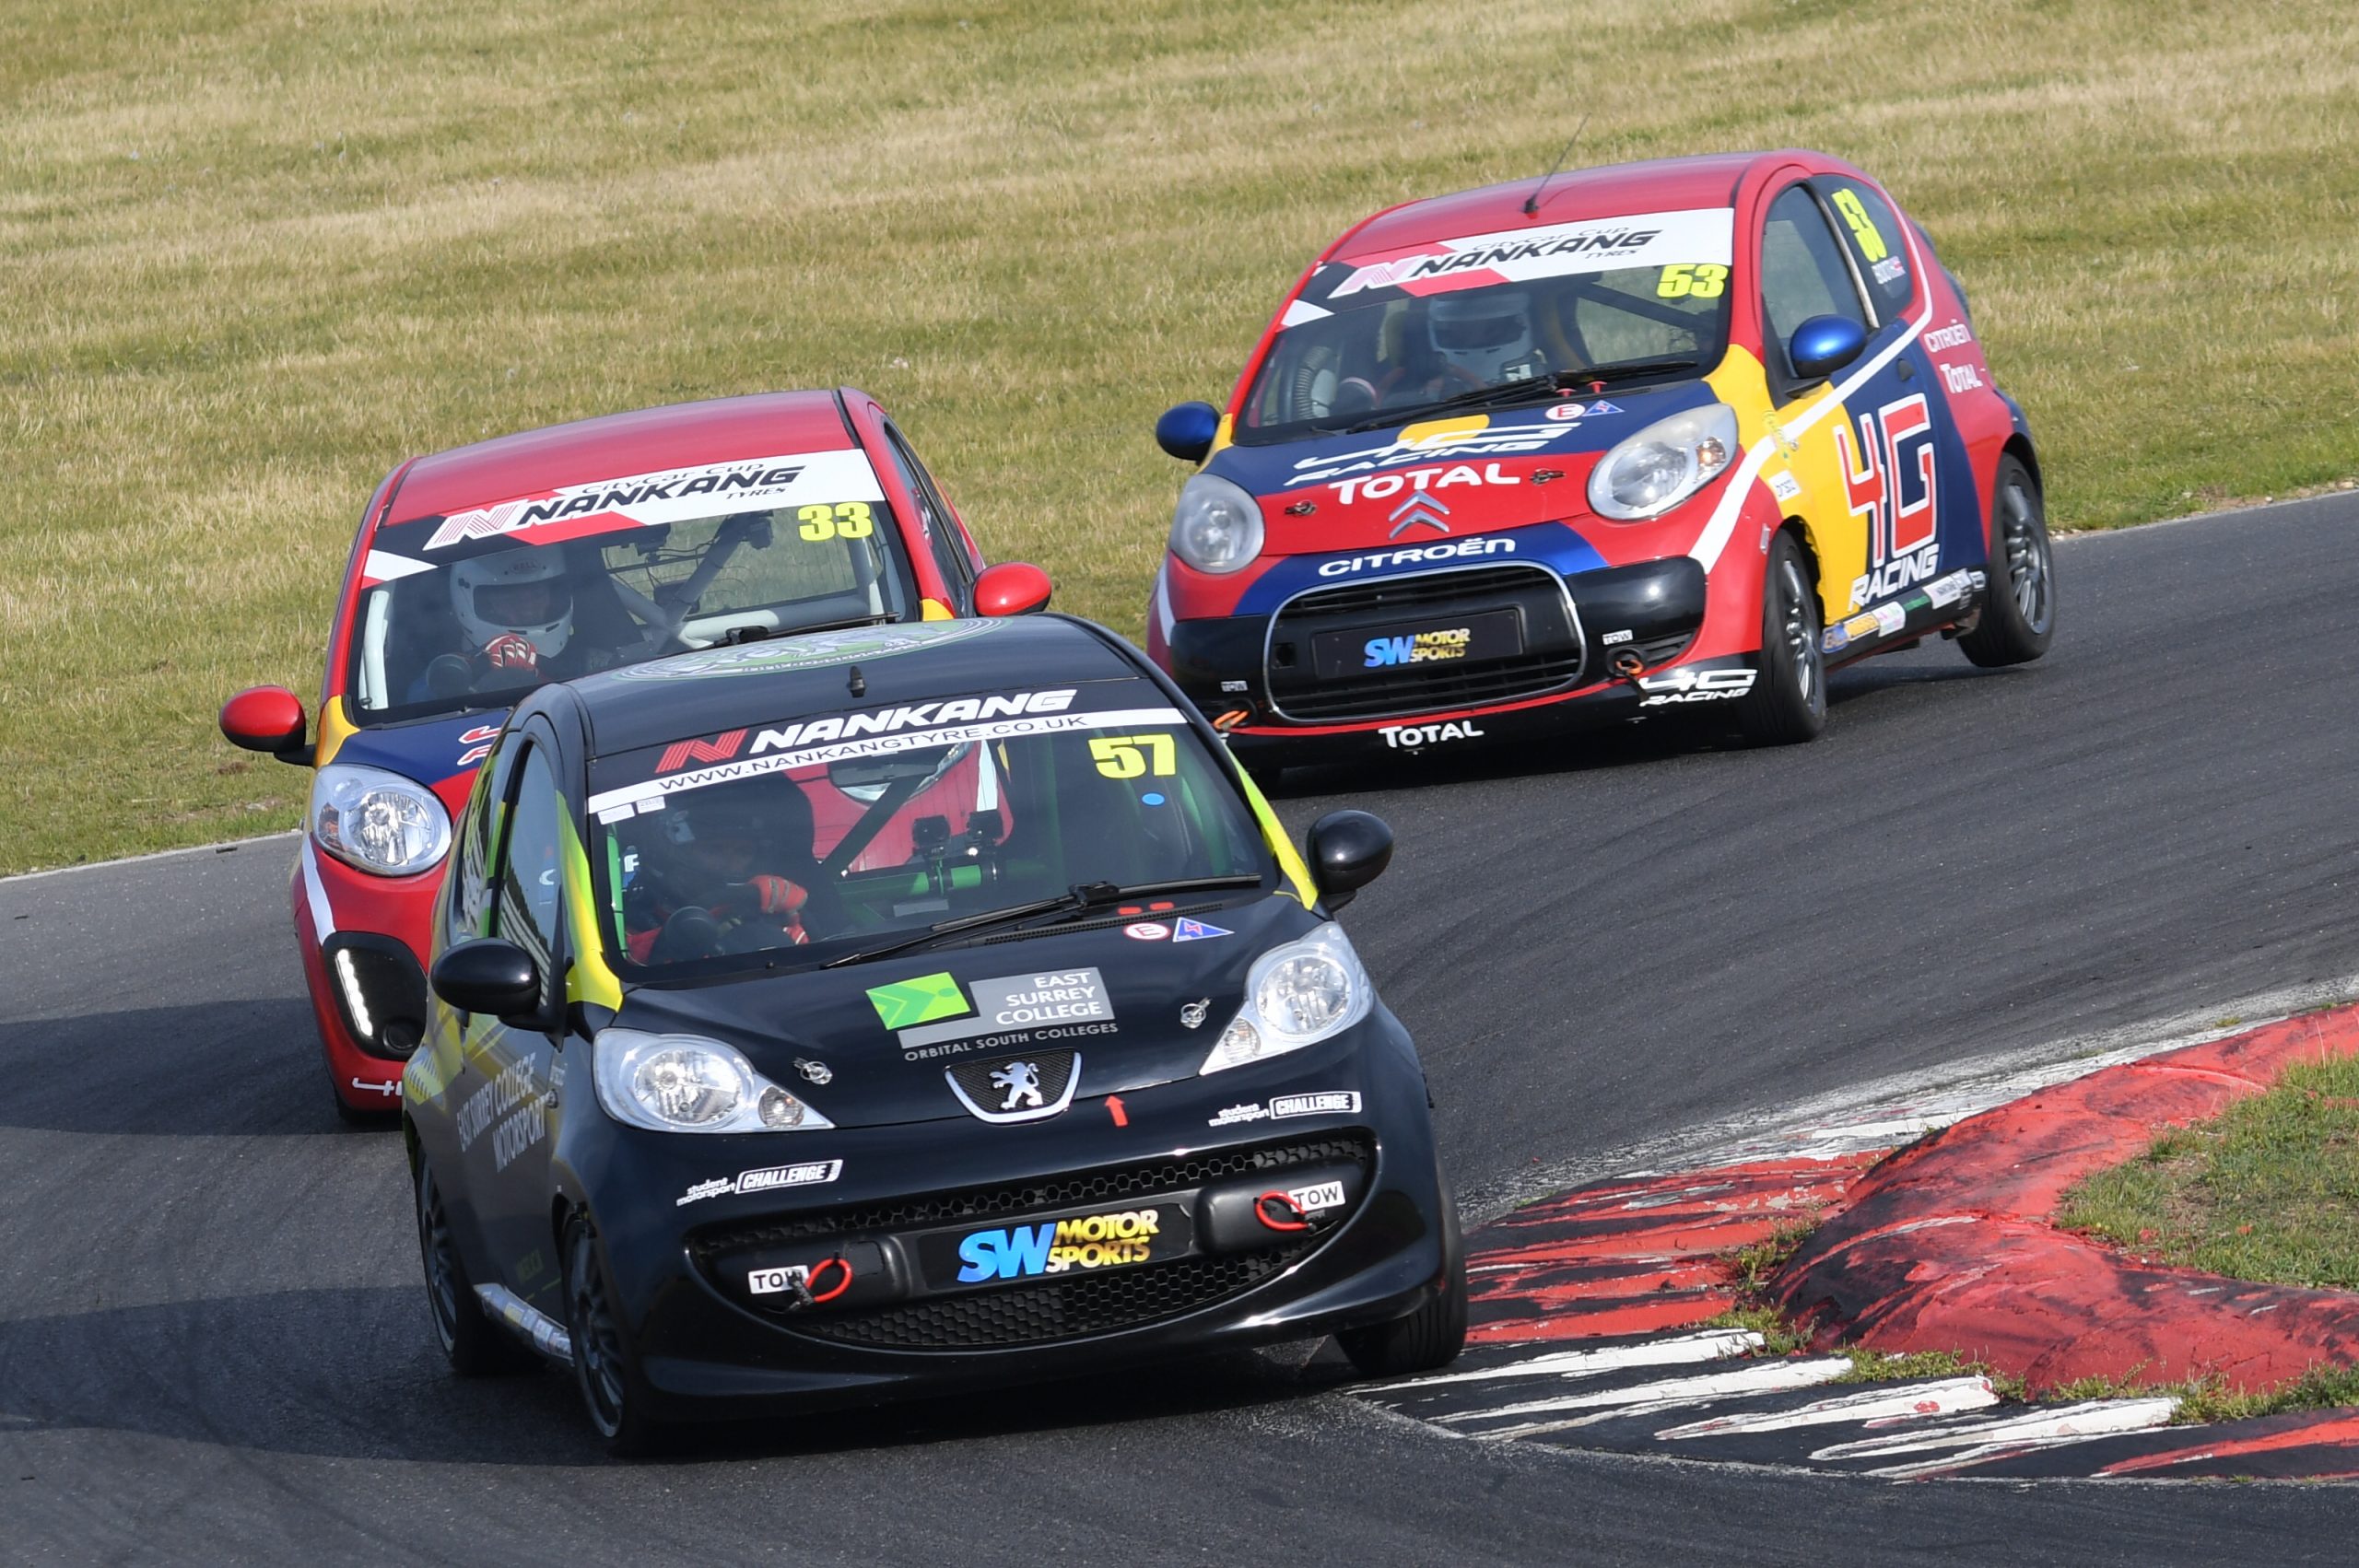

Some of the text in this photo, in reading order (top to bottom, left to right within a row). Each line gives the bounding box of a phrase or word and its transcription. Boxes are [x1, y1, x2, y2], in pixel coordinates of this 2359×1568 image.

[1831, 188, 1887, 263] 53
[1409, 229, 1662, 277] NANKANG
[1656, 263, 1729, 298] 53
[1939, 363, 1984, 394] TOTAL
[1284, 440, 1550, 486] RACING
[517, 465, 806, 526] NANKANG
[725, 487, 787, 500] TYRES
[1328, 462, 1521, 505] TOTAL
[1832, 392, 1937, 568] 4G
[798, 502, 874, 542] 33
[1848, 544, 1940, 613] RACING
[1364, 635, 1415, 667] SW
[1409, 644, 1465, 663] SPORTS
[1414, 628, 1471, 648] MOTOR
[1604, 631, 1632, 643] TOW
[1639, 688, 1750, 707] RACING
[748, 688, 1077, 755] NANKANG
[1379, 720, 1485, 748] TOTAL
[659, 715, 1089, 790] WWW.NANKANGTYRE.CO.UK
[1088, 733, 1177, 779] 57
[1006, 986, 1097, 1008] SURREY
[1036, 972, 1091, 989] EAST
[995, 1001, 1103, 1025] COLLEGE
[904, 1023, 1119, 1062] ORBITAL SOUTH COLLEGES
[1275, 1094, 1351, 1115] CHALLENGE
[687, 1177, 728, 1195] student
[743, 1164, 827, 1188] CHALLENGE
[676, 1183, 735, 1207] motorsport
[1293, 1186, 1339, 1207] TOW
[1053, 1210, 1160, 1246] MOTOR
[957, 1223, 1057, 1282] SW
[1045, 1236, 1151, 1273] SPORTS
